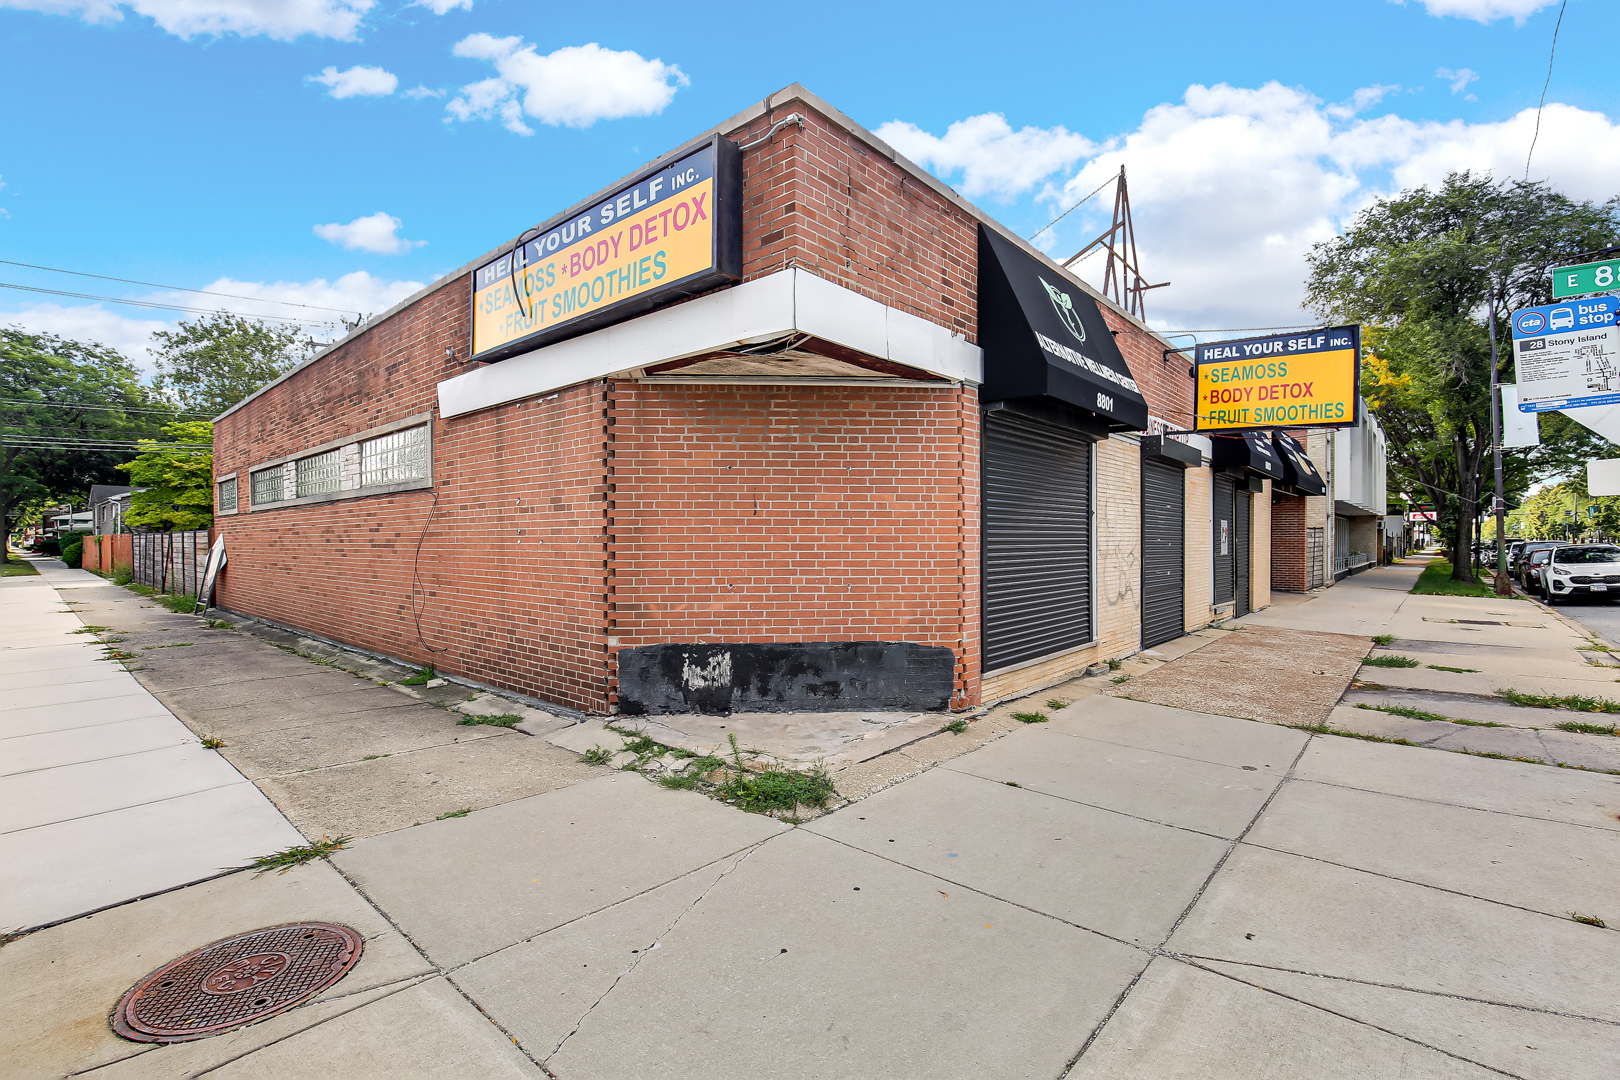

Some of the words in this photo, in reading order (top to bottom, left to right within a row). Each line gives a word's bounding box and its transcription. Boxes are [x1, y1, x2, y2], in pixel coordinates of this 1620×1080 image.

[484, 249, 529, 285] HEAL
[534, 215, 592, 257] YOUR
[600, 176, 664, 225] SELF
[671, 167, 699, 191] INC.
[485, 262, 555, 314] SEAMOSS
[569, 231, 623, 278] BODY
[629, 192, 708, 251] DETOX
[1567, 274, 1579, 288] E
[1594, 265, 1620, 287] 8
[505, 299, 548, 338] FRUIT
[552, 250, 667, 318] SMOOTHIES
[1578, 303, 1608, 315] bus
[1579, 312, 1615, 326] stop
[1522, 319, 1541, 328] cta
[1204, 346, 1240, 361] HEAL
[1243, 341, 1284, 356] YOUR
[1287, 336, 1326, 351] SELF
[1330, 337, 1352, 347] INC.
[1530, 341, 1544, 350] 28
[1548, 336, 1576, 347] Stony
[1578, 333, 1608, 343] Island
[1211, 362, 1288, 383] SEAMOSS
[1096, 392, 1113, 413] 8801
[1210, 387, 1254, 404] BODY
[1258, 382, 1314, 401] DETOX
[1209, 408, 1250, 425] FRUIT
[1254, 402, 1345, 422] SMOOTHIES
